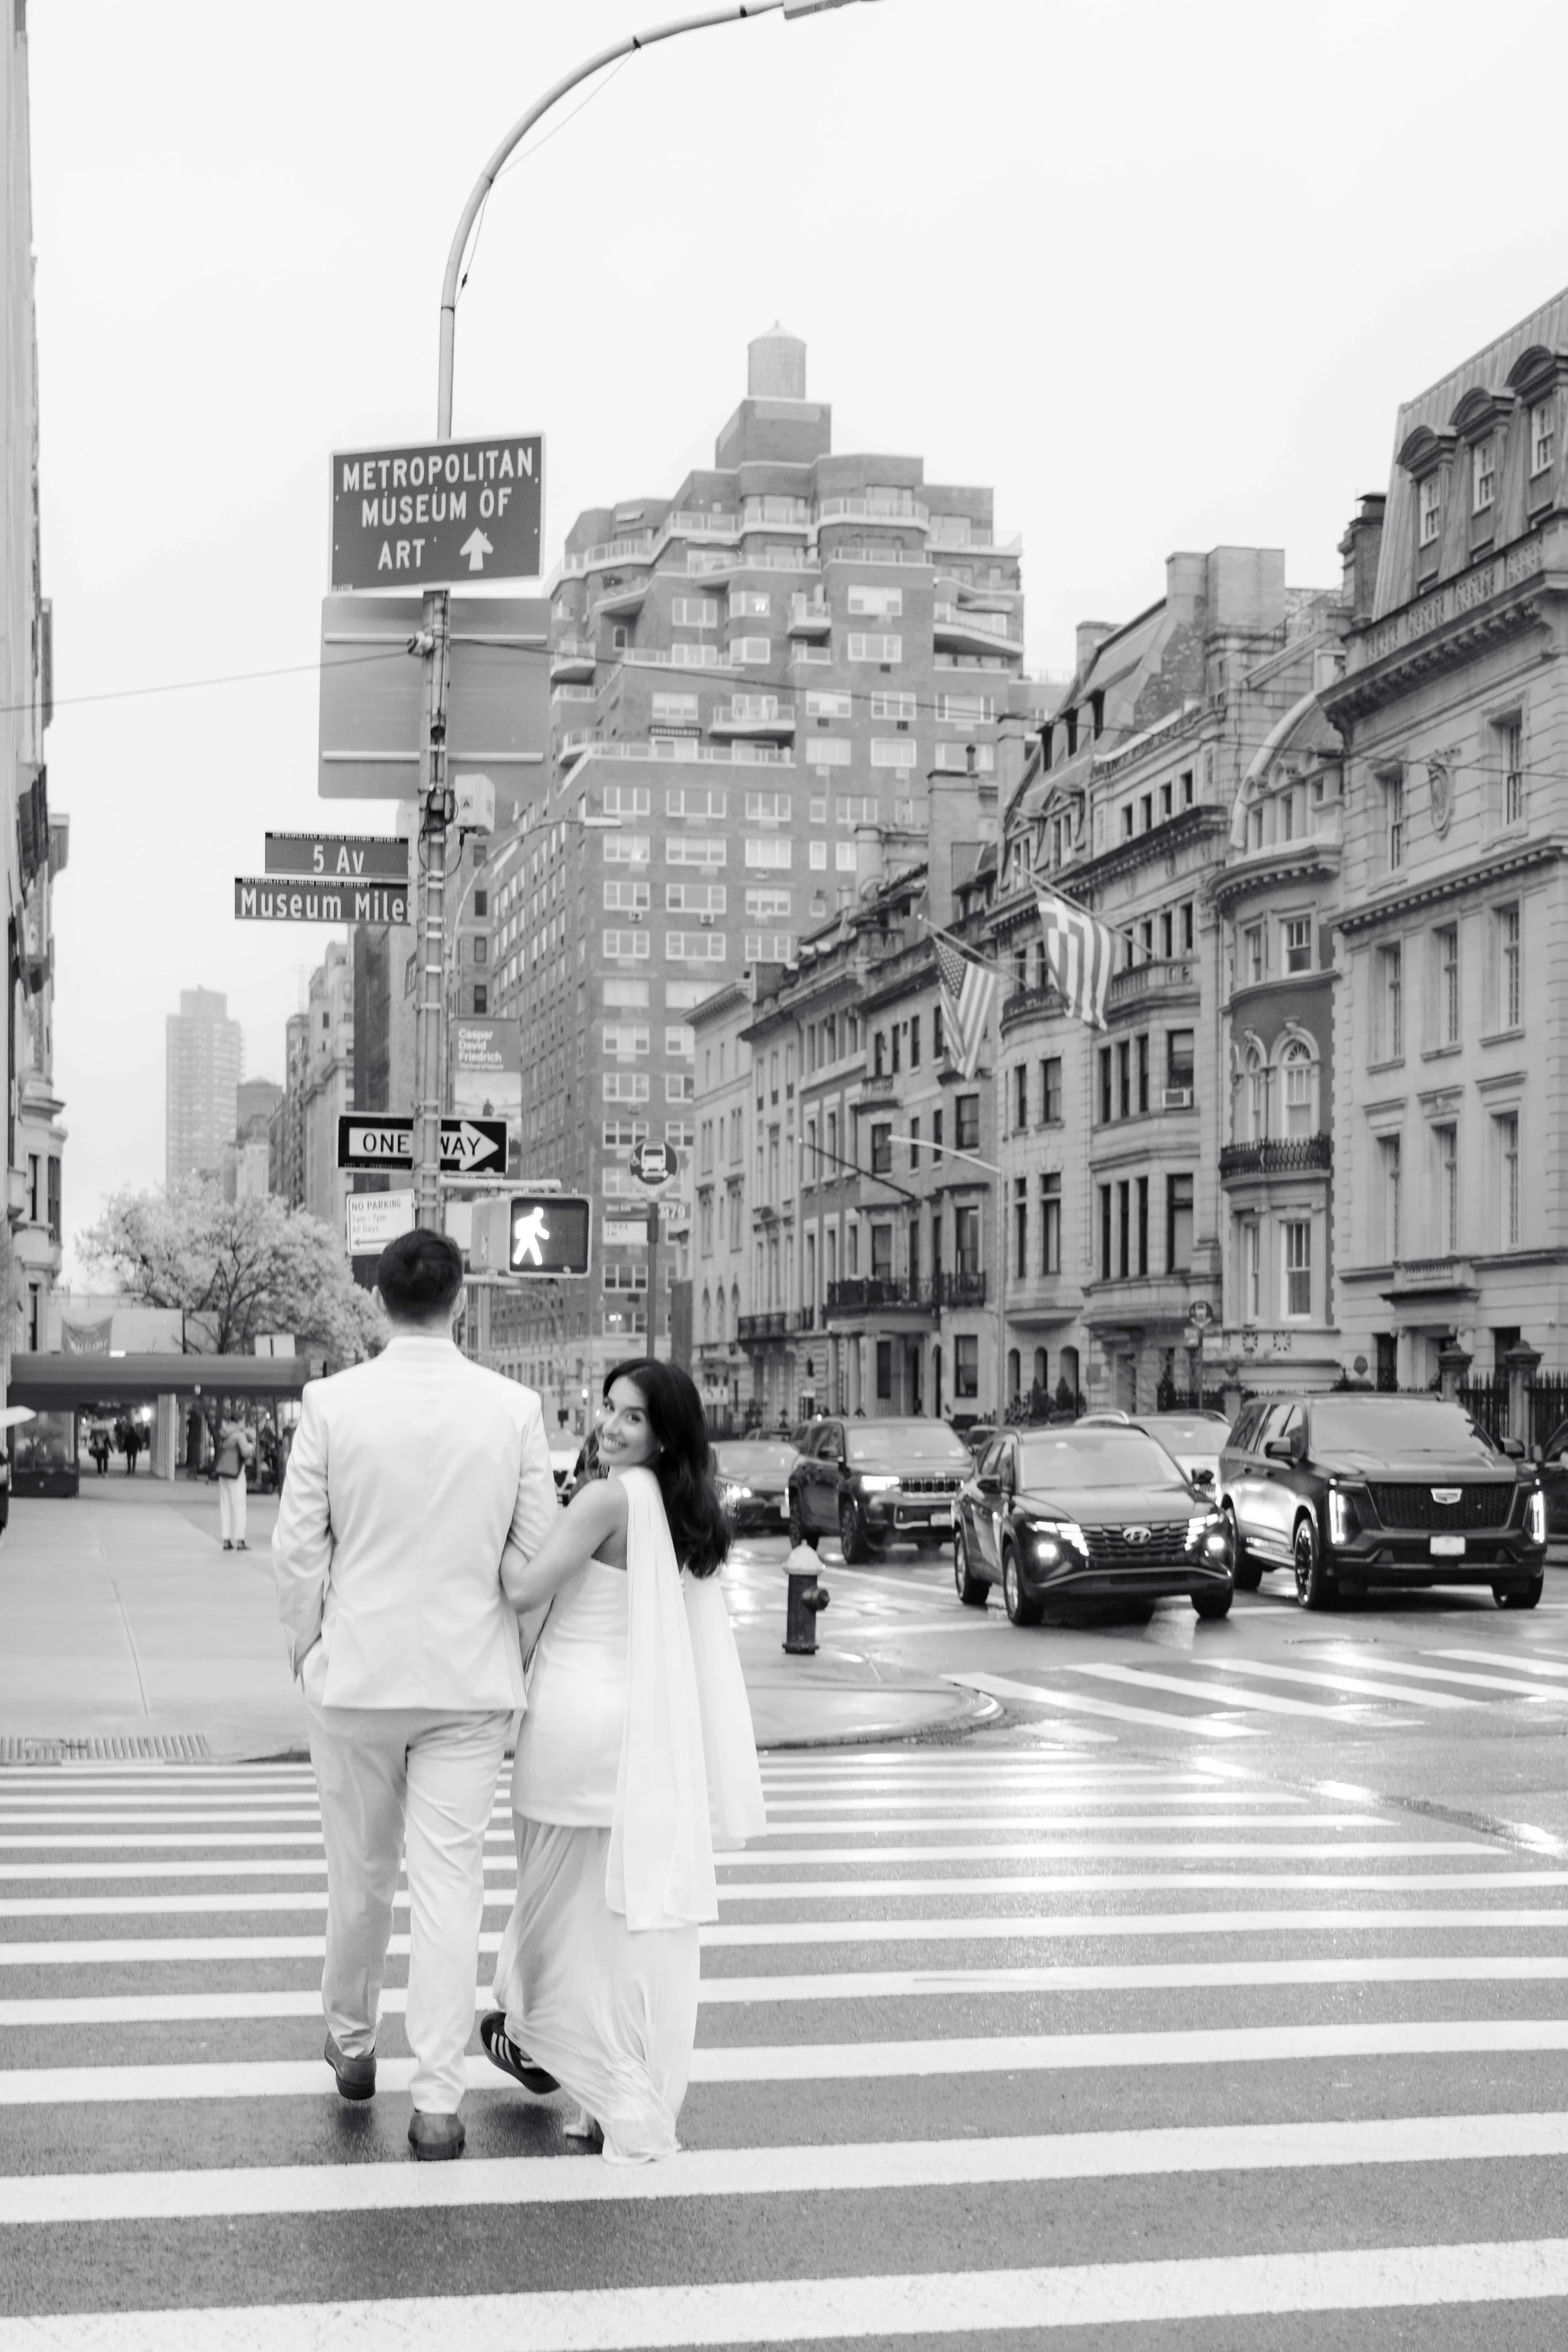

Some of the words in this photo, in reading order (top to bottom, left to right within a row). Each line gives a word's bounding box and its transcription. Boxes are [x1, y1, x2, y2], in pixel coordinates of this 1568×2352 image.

[343, 447, 532, 492] METROPOLITAN
[362, 491, 467, 528] MUSEUM
[480, 487, 512, 518] OF
[378, 539, 425, 571] ART
[313, 844, 324, 874] 5
[336, 845, 364, 875] Av
[241, 887, 342, 920] Museum
[355, 890, 405, 922] Mile
[458, 1040, 487, 1051] David
[458, 1051, 502, 1062] Friedrich
[363, 1133, 410, 1153] ONE
[352, 1202, 364, 1211] NO
[367, 1197, 401, 1210] PARKING
[364, 1225, 378, 1234] Days
